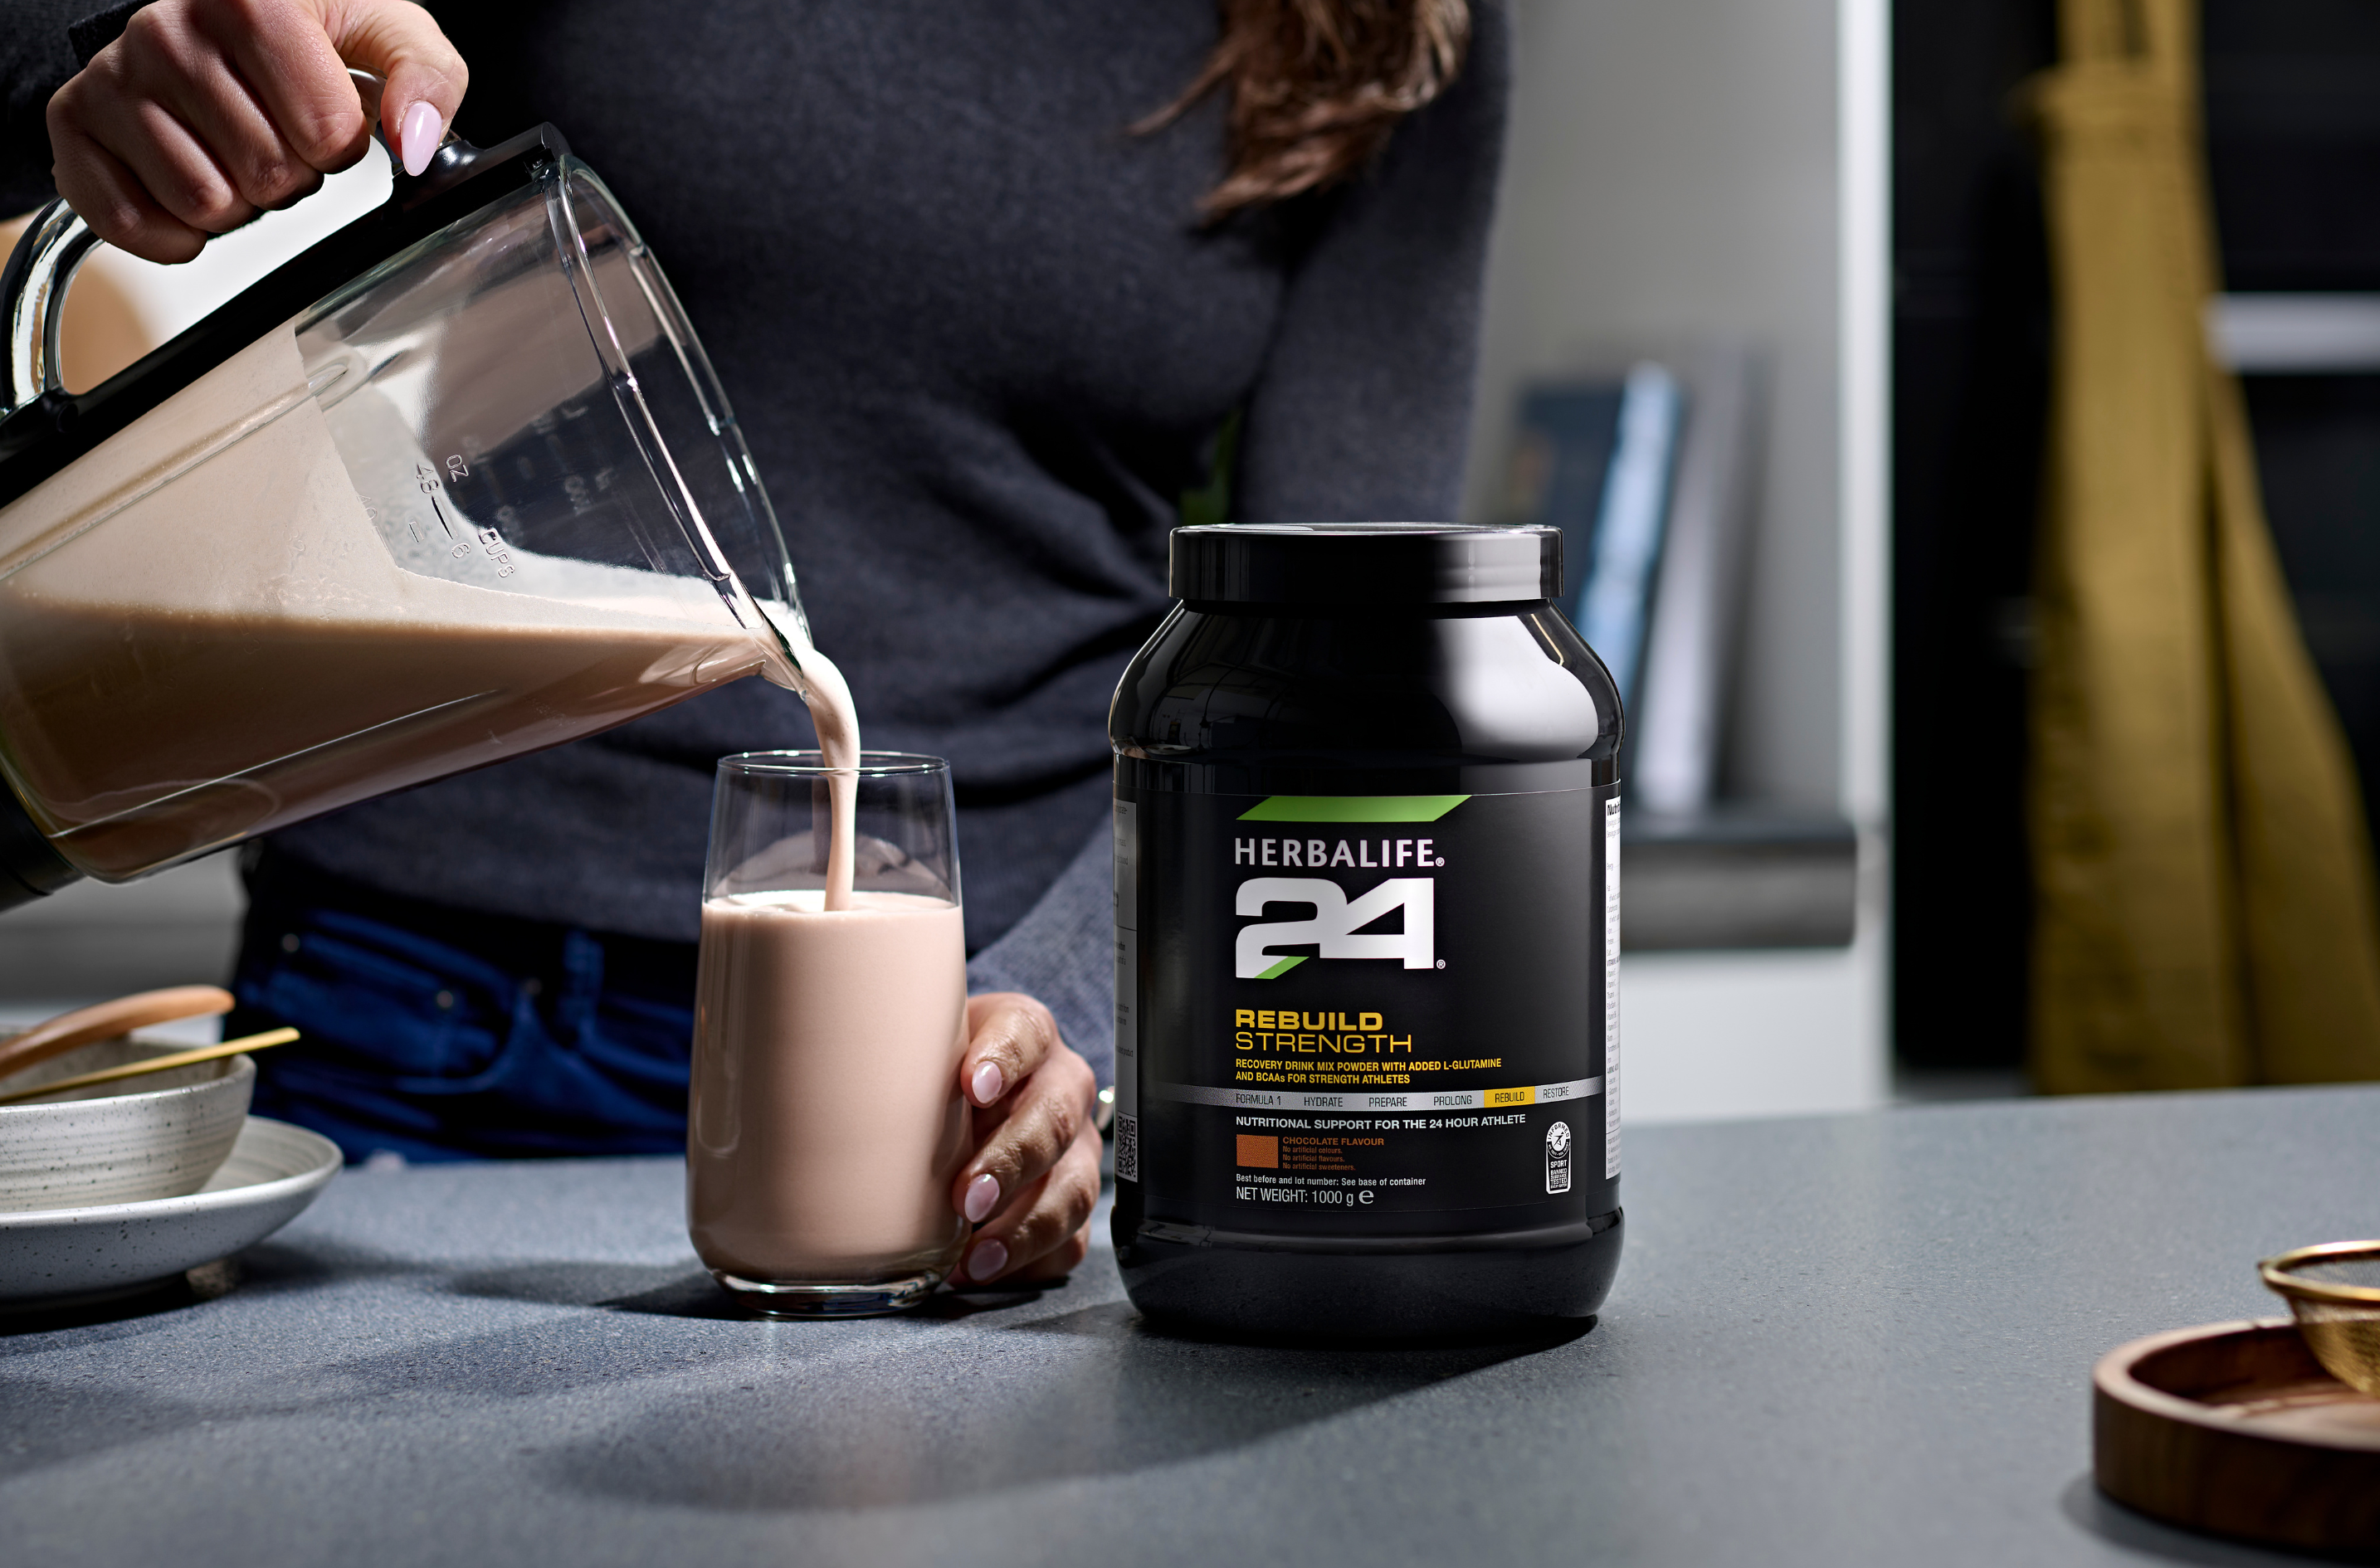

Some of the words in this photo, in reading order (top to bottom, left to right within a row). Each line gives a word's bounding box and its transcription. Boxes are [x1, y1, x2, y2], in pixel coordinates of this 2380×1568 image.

[445, 454, 469, 482] OZ
[417, 463, 439, 494] 48
[478, 528, 515, 578] CUPS
[1236, 1009, 1383, 1031] REBUILD
[1236, 1031, 1412, 1054] STRENGTH
[1236, 1059, 1283, 1070] RECOVERY
[1285, 1060, 1314, 1071] DRINK
[1317, 1062, 1334, 1071] MIX
[1337, 1062, 1379, 1072] POWDER
[1382, 1062, 1406, 1072] WITH
[1408, 1061, 1441, 1071] ADDED
[1443, 1058, 1502, 1070] L-GLUTAMINE
[1236, 1071, 1254, 1081] AND
[1256, 1073, 1285, 1083] BCAAs
[1288, 1074, 1306, 1083] FOR
[1309, 1074, 1359, 1083] STRENGTH
[1362, 1074, 1411, 1084] ATHLETES
[1495, 1092, 1525, 1103] REBUILD
[1544, 1087, 1569, 1098] RESTORE
[1236, 1093, 1274, 1105] FORMULA
[1276, 1096, 1281, 1105] 1
[1304, 1097, 1344, 1108] HYDRATE
[1368, 1097, 1407, 1108] PREPARE
[1433, 1095, 1472, 1106] PROLONG
[1236, 1116, 1311, 1128] NUTRITIONAL
[1314, 1120, 1372, 1129] SUPPORT
[1375, 1120, 1400, 1130] FOR
[1402, 1120, 1427, 1129] THE
[1429, 1119, 1442, 1128] 24
[1446, 1118, 1479, 1128] HOUR
[1481, 1113, 1526, 1126] ATHLETE
[1548, 1122, 1570, 1140] INFORMED
[1282, 1137, 1339, 1146] CHOCOLATE
[1341, 1137, 1384, 1146] FLAVOUR
[1292, 1146, 1317, 1154] artificial
[1292, 1154, 1317, 1162] artificial
[1292, 1162, 1317, 1171] artificial
[1550, 1160, 1568, 1169] SPORT
[1236, 1174, 1252, 1182] Best
[1253, 1175, 1276, 1184] before
[1279, 1176, 1293, 1185] and
[1295, 1176, 1305, 1185] lot
[1307, 1177, 1339, 1186] number:
[1358, 1178, 1377, 1186] base
[1379, 1177, 1388, 1186] of
[1389, 1177, 1427, 1186] container
[1236, 1186, 1258, 1200] NET
[1260, 1188, 1309, 1203] WEIGHT:
[1311, 1191, 1343, 1204] 1000
[1346, 1193, 1354, 1206] g
